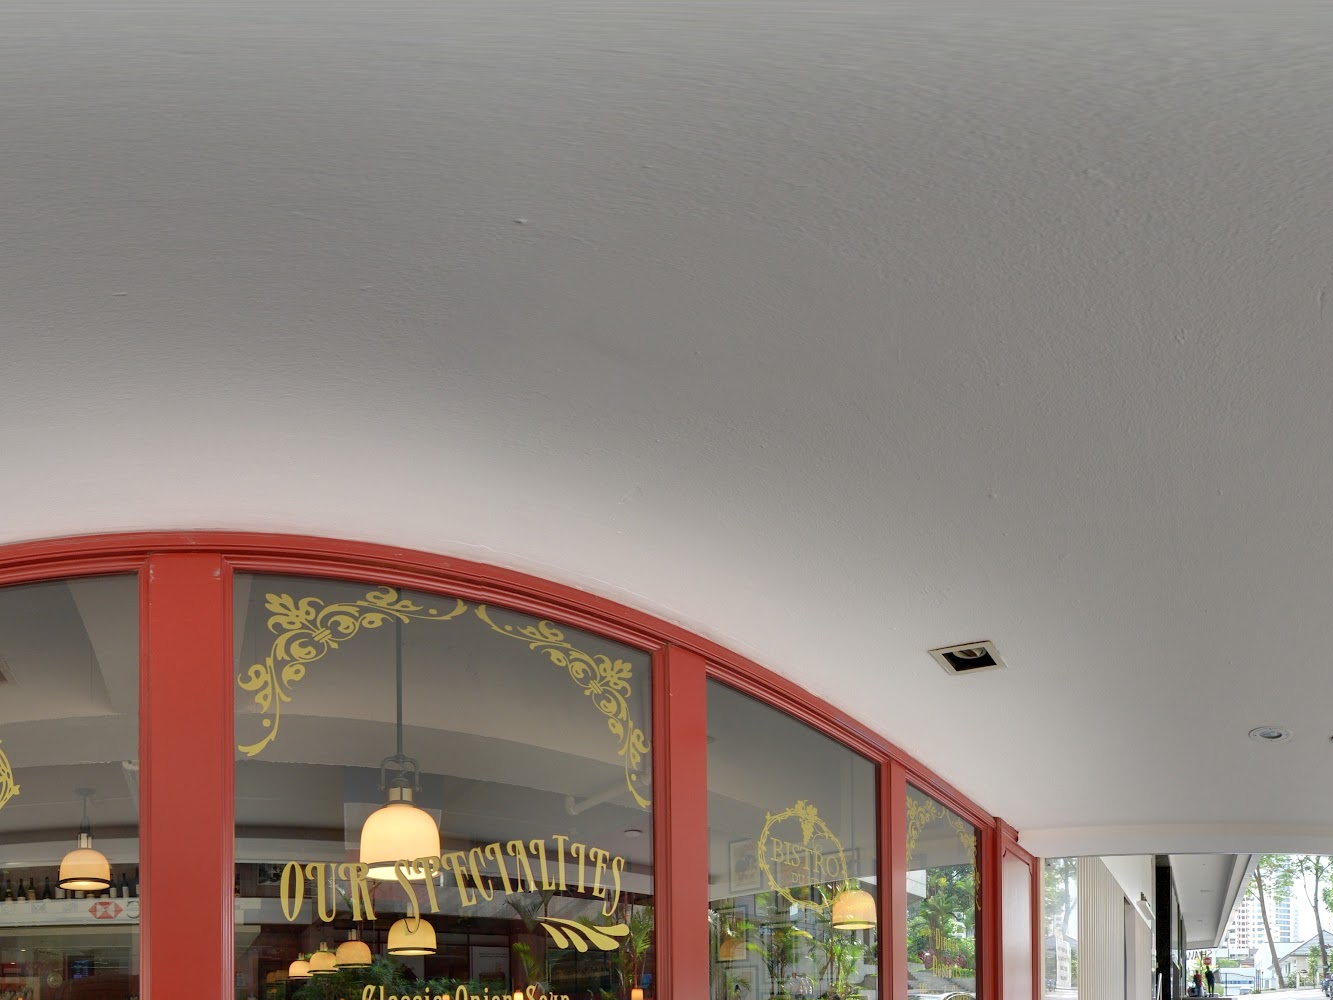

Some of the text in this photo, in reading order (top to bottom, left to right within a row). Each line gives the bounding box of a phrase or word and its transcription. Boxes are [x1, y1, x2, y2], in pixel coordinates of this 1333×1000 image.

[770, 837, 840, 877] BISTRO
[280, 834, 625, 934] OUR SPECIALTIES
[791, 872, 806, 885] DU
